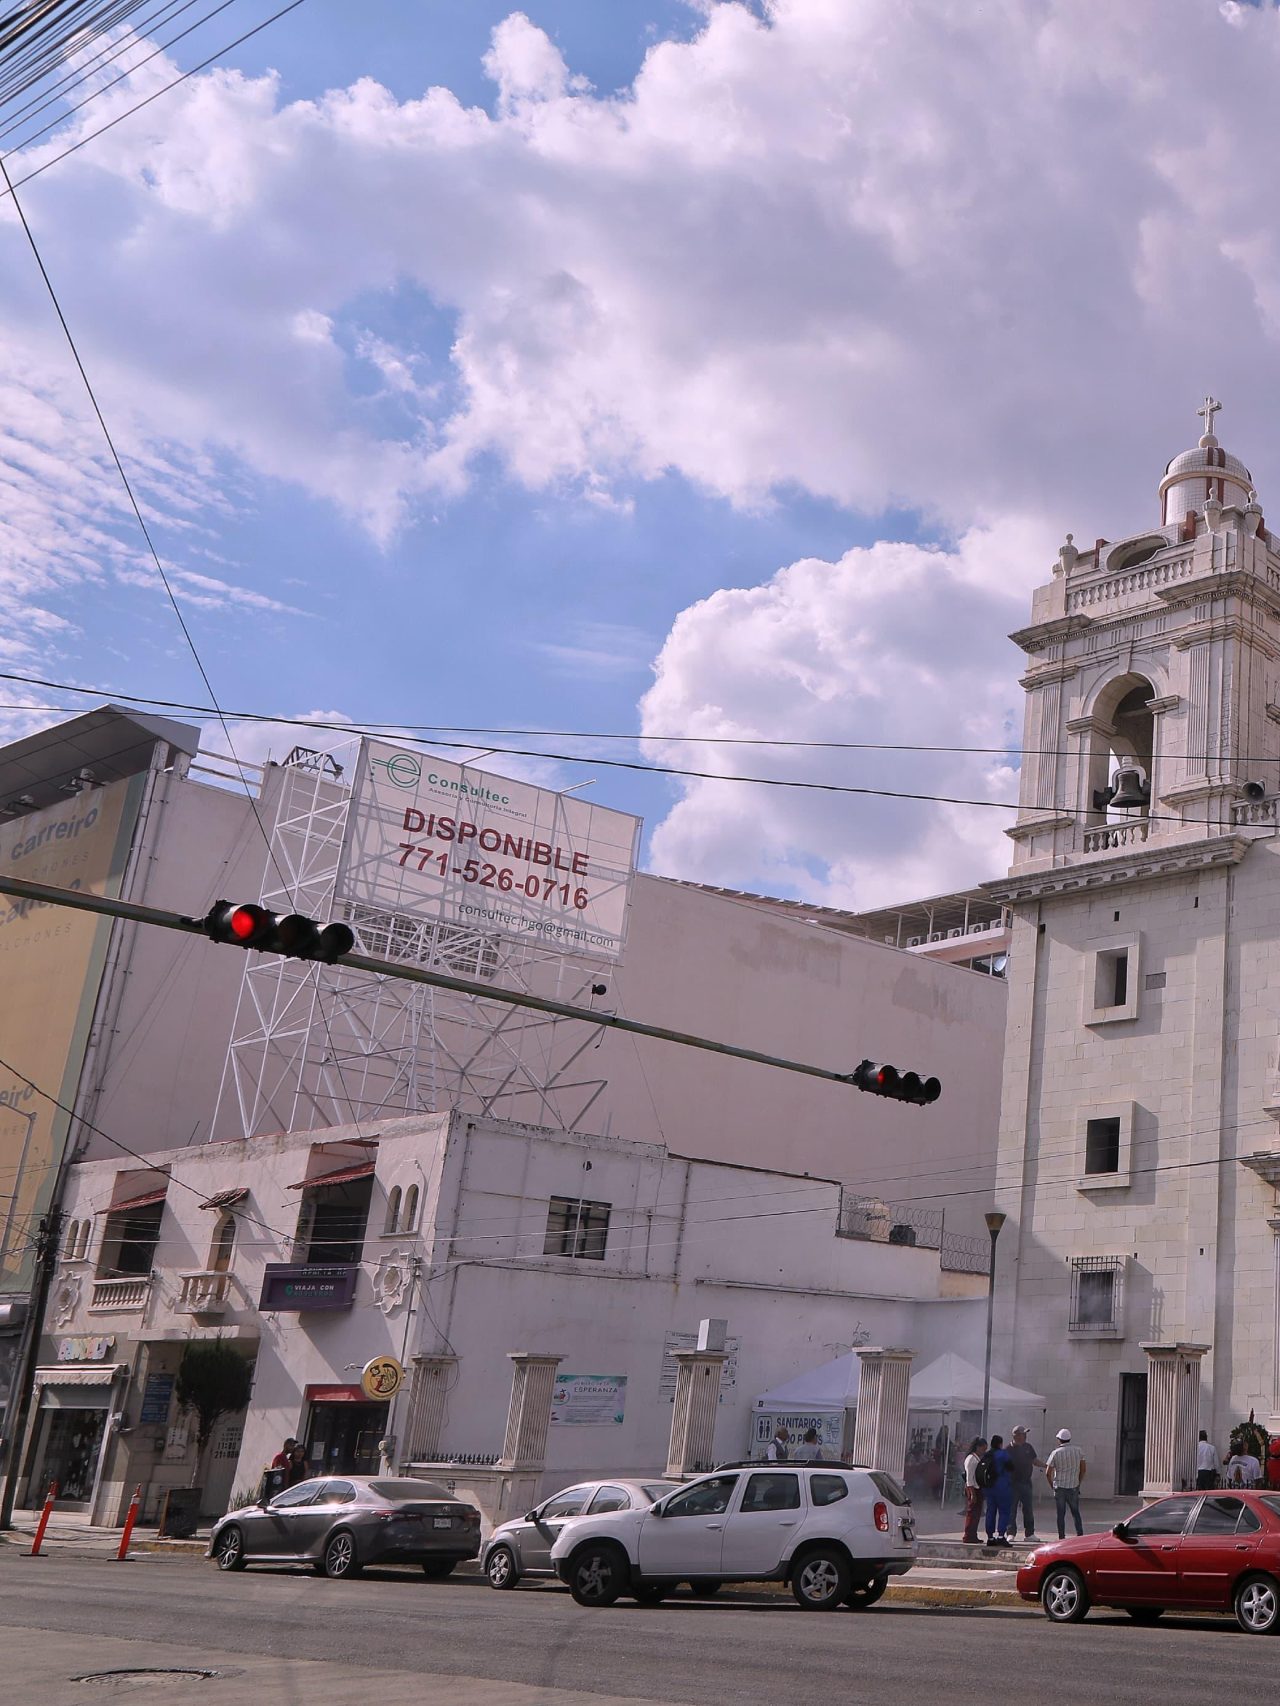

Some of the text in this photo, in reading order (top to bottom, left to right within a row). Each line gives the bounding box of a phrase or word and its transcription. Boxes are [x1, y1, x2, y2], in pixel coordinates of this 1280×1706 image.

[428, 773, 510, 805] Consultec
[10, 807, 98, 860] carreiro
[402, 807, 590, 877] DISPONIBLE
[398, 842, 589, 910] 771-526-0716
[458, 902, 614, 948] consultec.hgo@gmail.com
[776, 1417, 823, 1429] SANITARIOS
